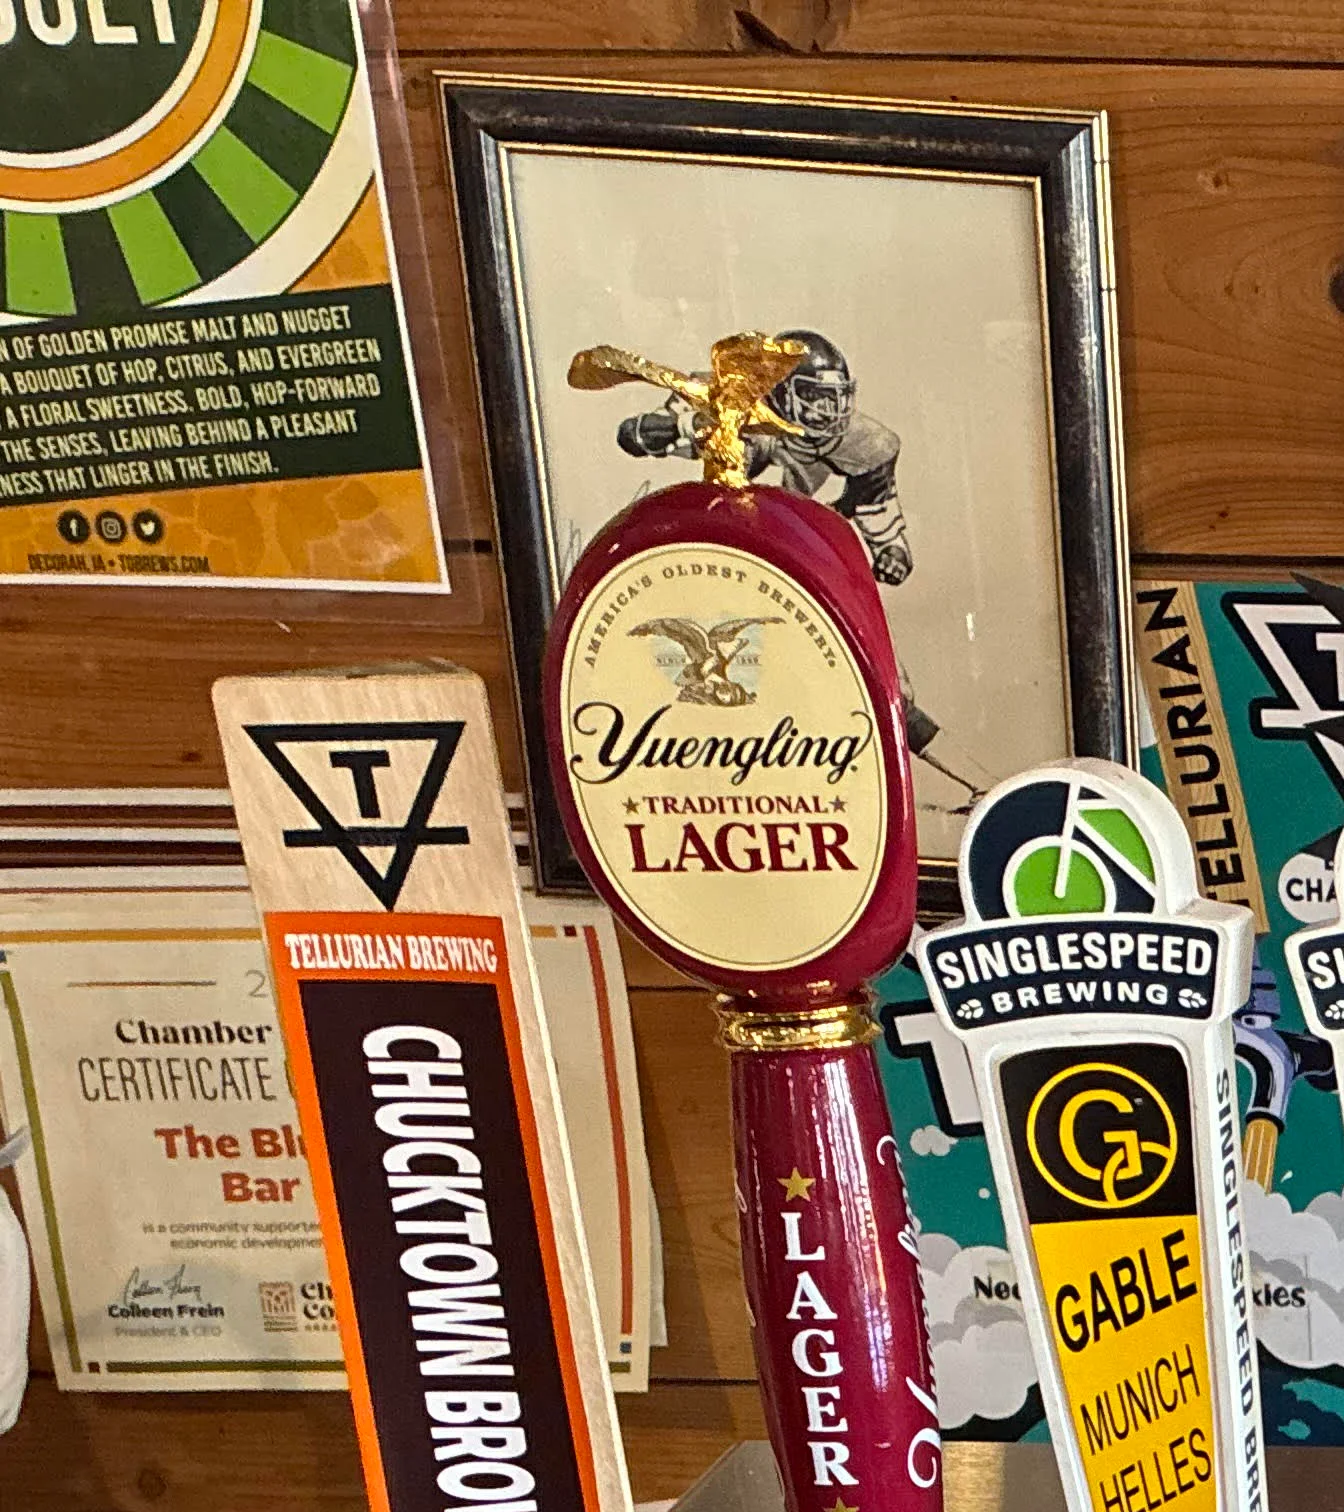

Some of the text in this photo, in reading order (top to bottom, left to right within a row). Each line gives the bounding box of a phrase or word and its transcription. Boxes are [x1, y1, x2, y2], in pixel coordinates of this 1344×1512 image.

[12, 337, 34, 361] OF
[38, 331, 109, 358] GOLDEN
[113, 320, 189, 351] PROMISE
[192, 316, 237, 343] MALT
[242, 313, 278, 338] AND
[283, 305, 352, 333] NUGGET
[0, 338, 382, 395] A BOUQUET OF HOP, CITRUS, AND EVERGREEN
[5, 372, 381, 430] A FLORAL SWEETNESS. BOLD, HOP-FORWARD
[1, 409, 358, 464] THE SENSES, LEAVING BEHIND A PLEASANT
[46, 466, 86, 492] THAT
[89, 459, 153, 489] LINGER
[155, 458, 174, 482] IN
[177, 453, 209, 480] THE
[213, 449, 279, 478] FINISH.
[584, 575, 653, 669] AMERICA'S
[662, 564, 747, 584] OLDEST
[643, 796, 829, 815] TRADITIONAL
[625, 822, 859, 874] LAGER
[284, 933, 498, 974] TELLURIAN BREWING
[936, 931, 1212, 990] SINGLESPEED
[990, 980, 1168, 1014] BREWING
[115, 1018, 272, 1045] Chamber
[77, 1057, 277, 1102] CERTIFICATE
[154, 1124, 241, 1159] The
[221, 1172, 301, 1203] Bar
[362, 1024, 516, 1377] CHUCKTOWN
[170, 1222, 249, 1235] community
[170, 1237, 238, 1249] economic
[1215, 1066, 1254, 1420] SINGLESPEED
[108, 1303, 225, 1319] Colleen Frein
[1054, 1228, 1198, 1353] GABLE
[779, 1210, 859, 1487] LAGER
[1080, 1344, 1201, 1457] MUNICH
